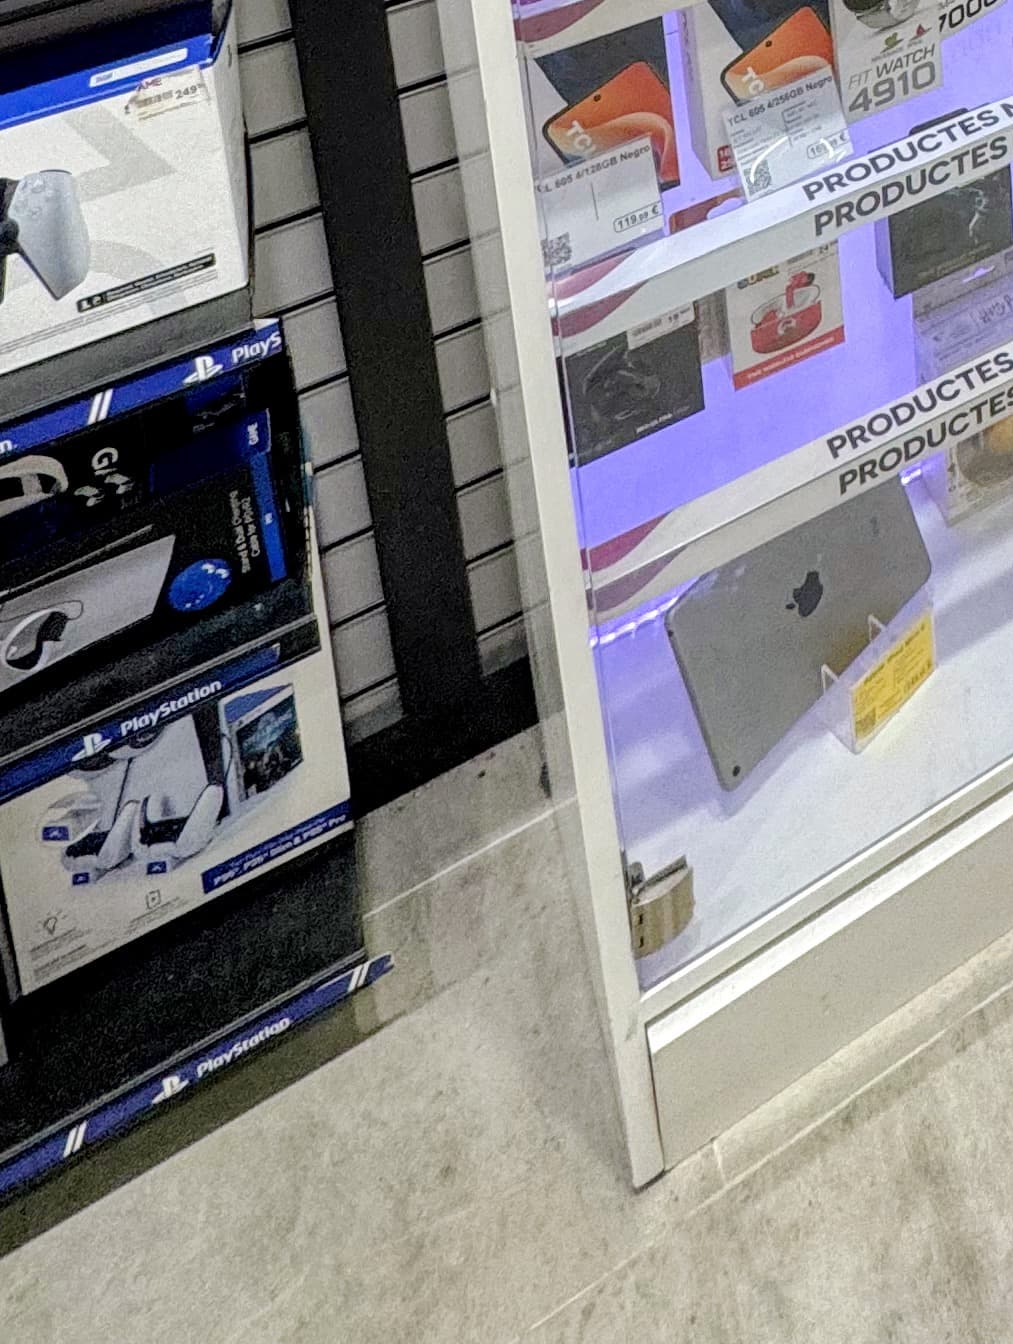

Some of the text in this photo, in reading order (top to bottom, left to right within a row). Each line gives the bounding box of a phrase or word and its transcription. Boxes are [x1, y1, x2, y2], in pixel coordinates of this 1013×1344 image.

[742, 67, 765, 97] TC
[848, 43, 935, 91] FIT WATCH
[848, 65, 936, 113] 4910
[620, 144, 651, 164] Negro
[803, 106, 999, 201] PRODUCTES
[815, 131, 1007, 237] PRODUCTES
[827, 350, 1013, 461] PRODUCTES
[120, 679, 222, 737] PlayStation
[197, 1016, 290, 1078] PlayStation
